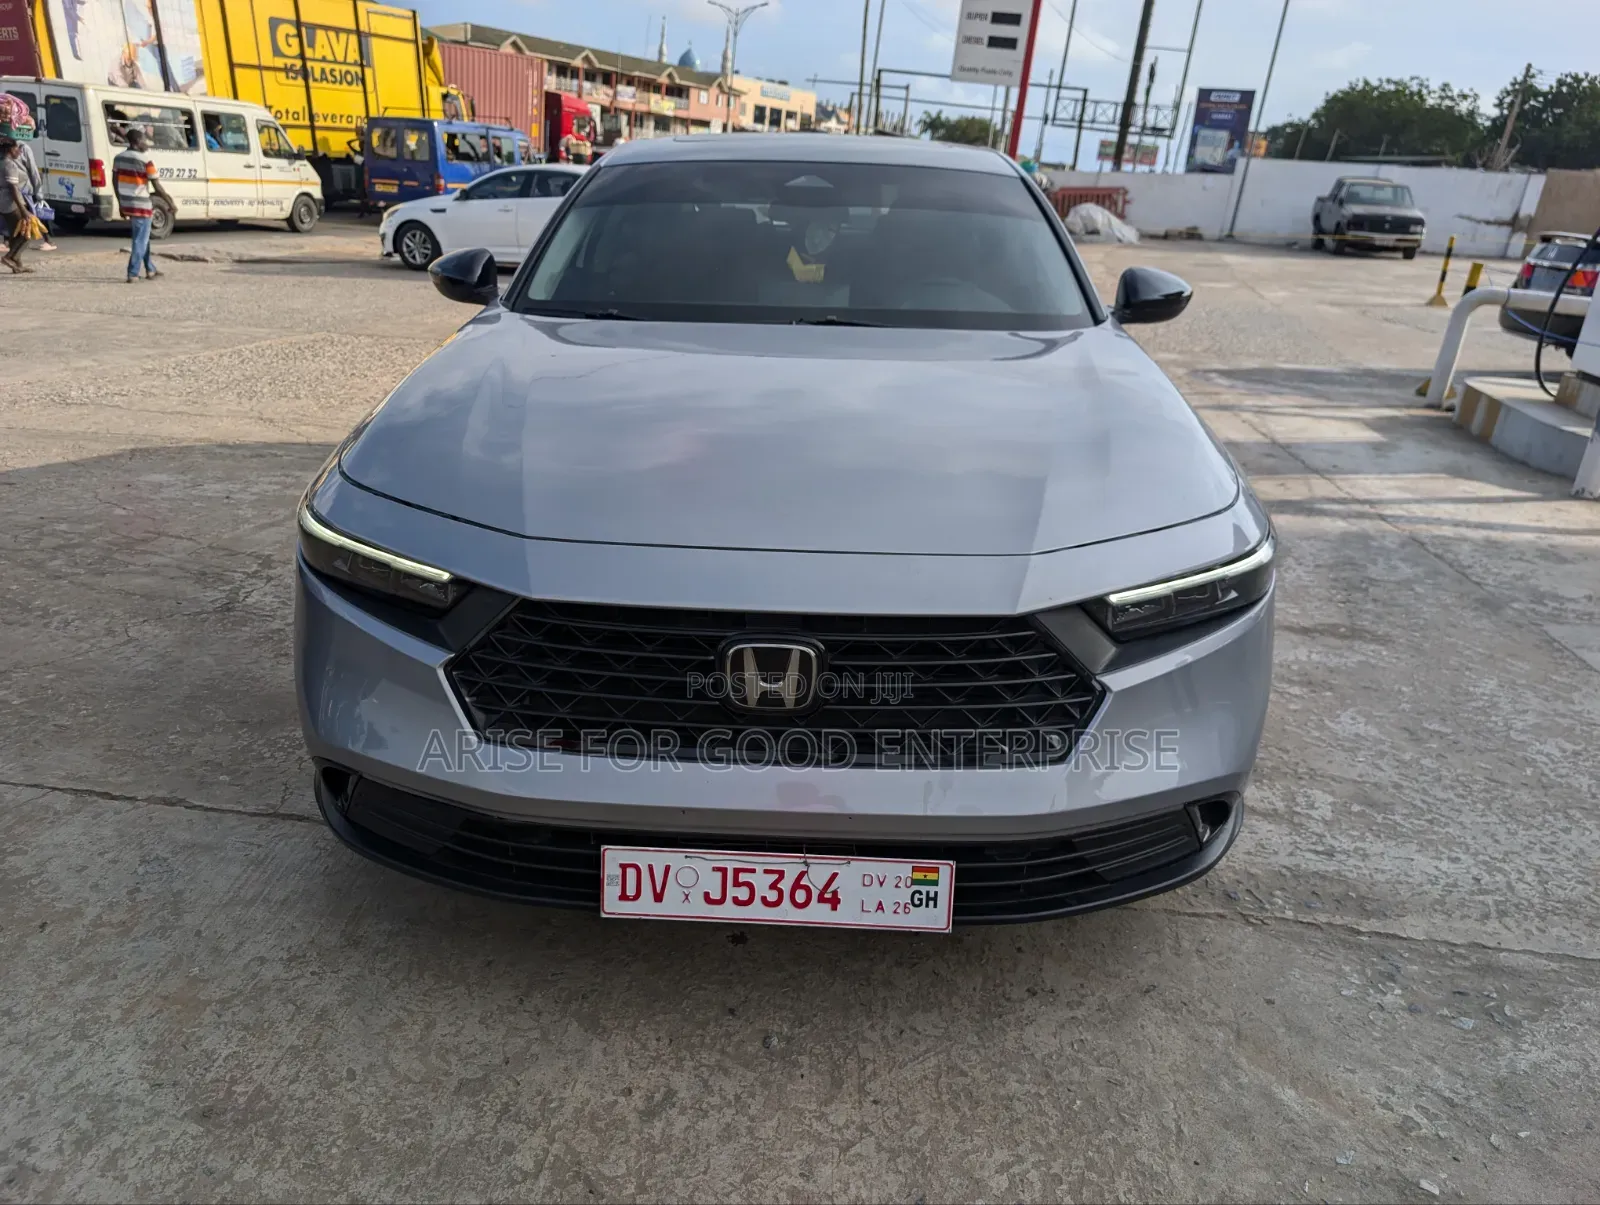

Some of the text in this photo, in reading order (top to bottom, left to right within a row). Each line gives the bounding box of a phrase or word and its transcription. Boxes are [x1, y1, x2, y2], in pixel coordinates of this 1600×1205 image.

[276, 23, 367, 66] GLAVA
[176, 169, 186, 178] 27
[618, 862, 671, 903] DV
[703, 866, 841, 912] J5364
[862, 873, 887, 888] DV
[861, 899, 912, 915] LA 26
[910, 889, 939, 909] GH
